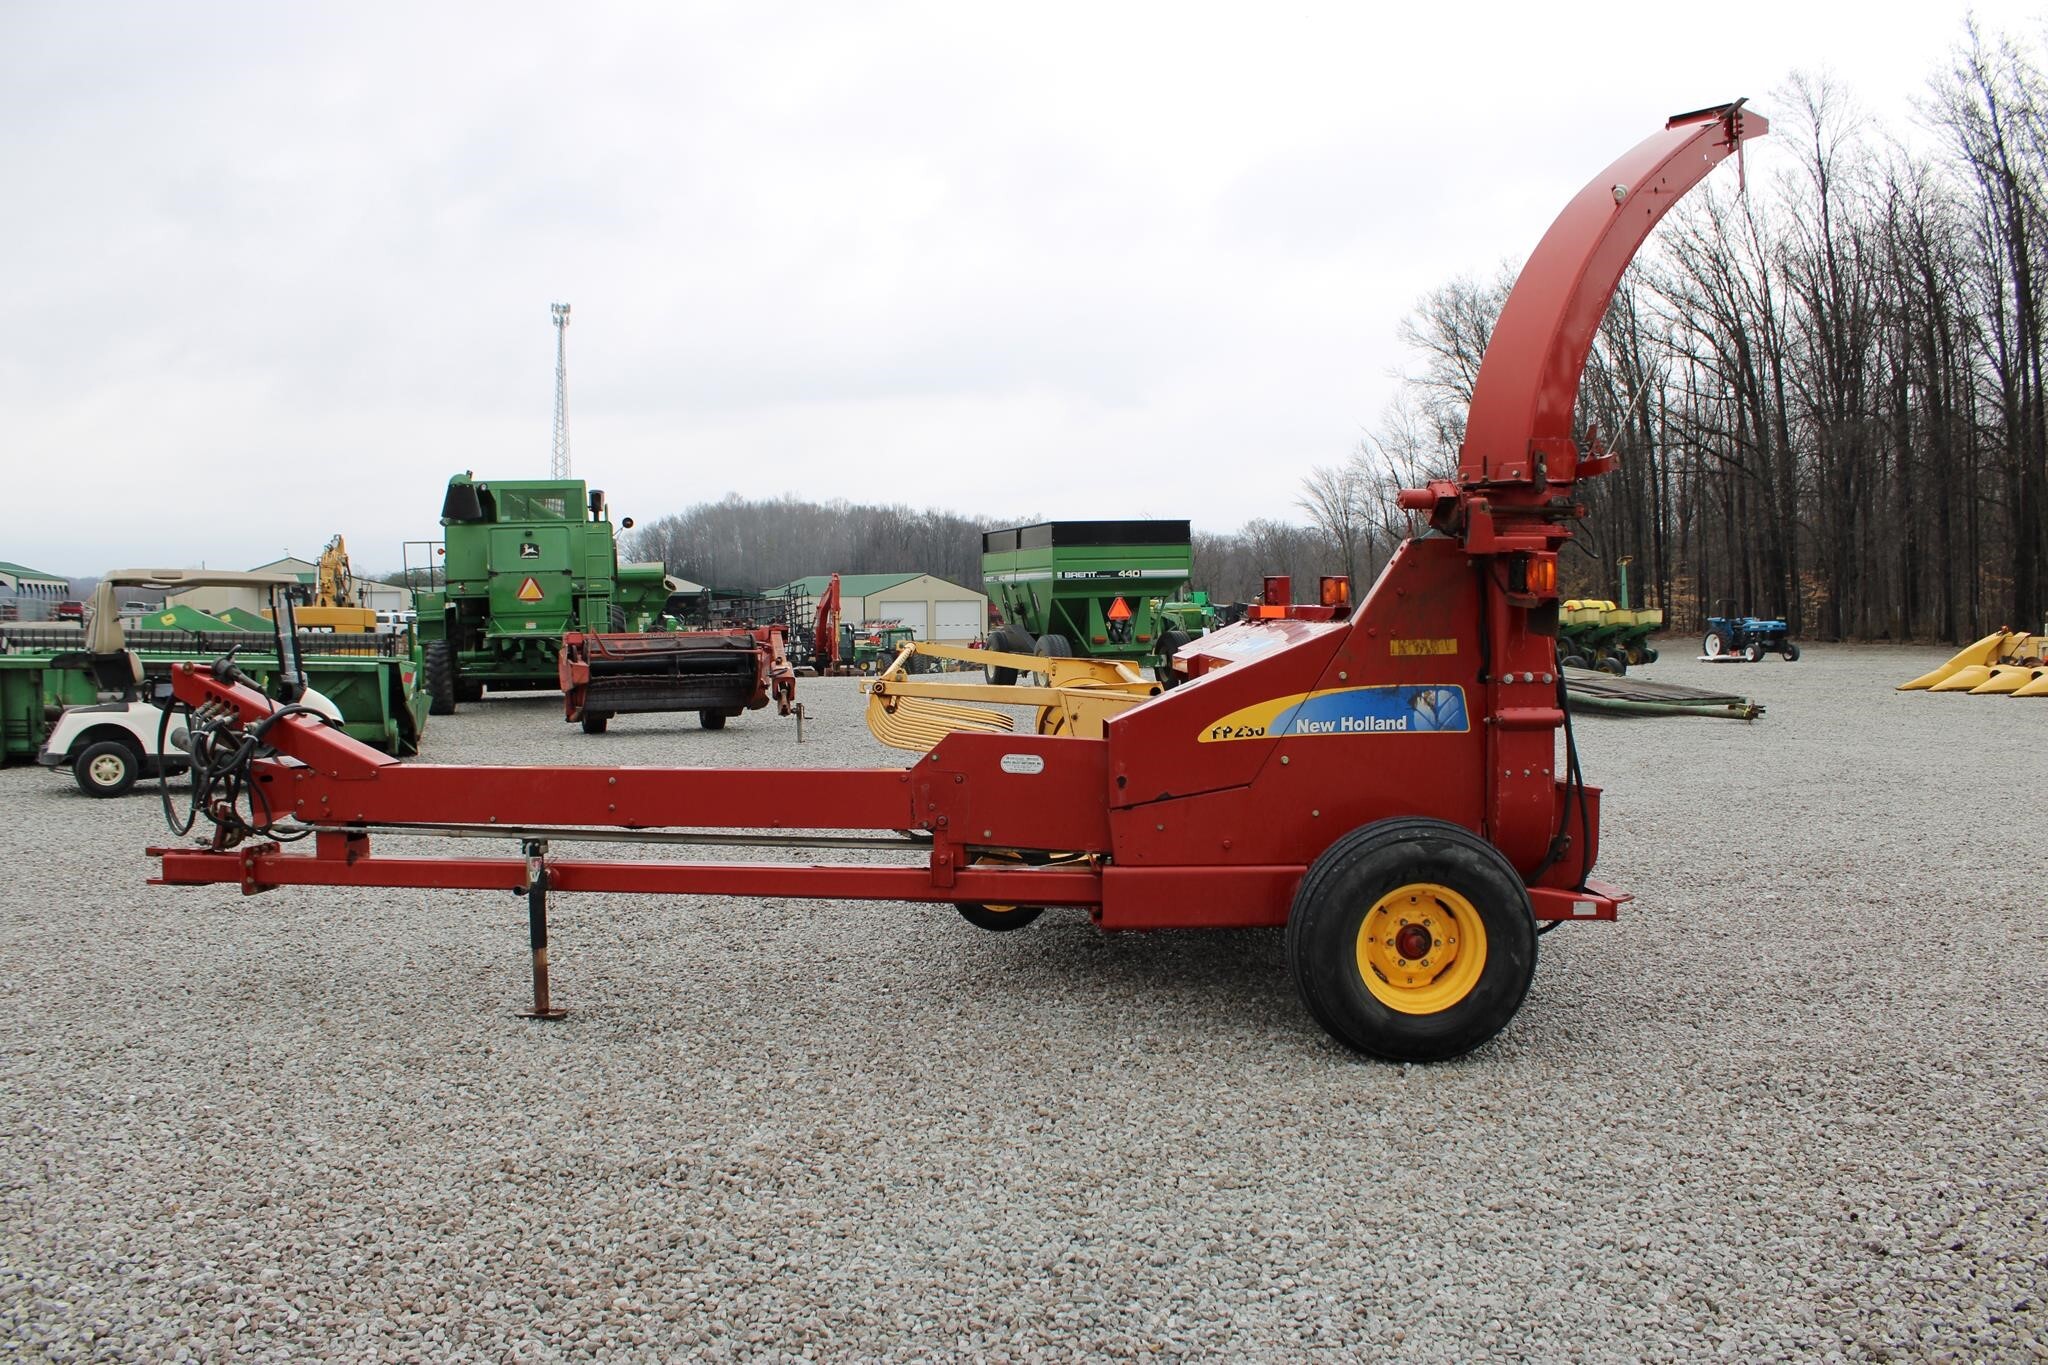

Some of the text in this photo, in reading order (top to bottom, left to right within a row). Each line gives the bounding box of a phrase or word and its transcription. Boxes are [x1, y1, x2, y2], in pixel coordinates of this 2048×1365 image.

[1064, 570, 1140, 579] BRENT 440
[1296, 715, 1408, 734] New Holland
